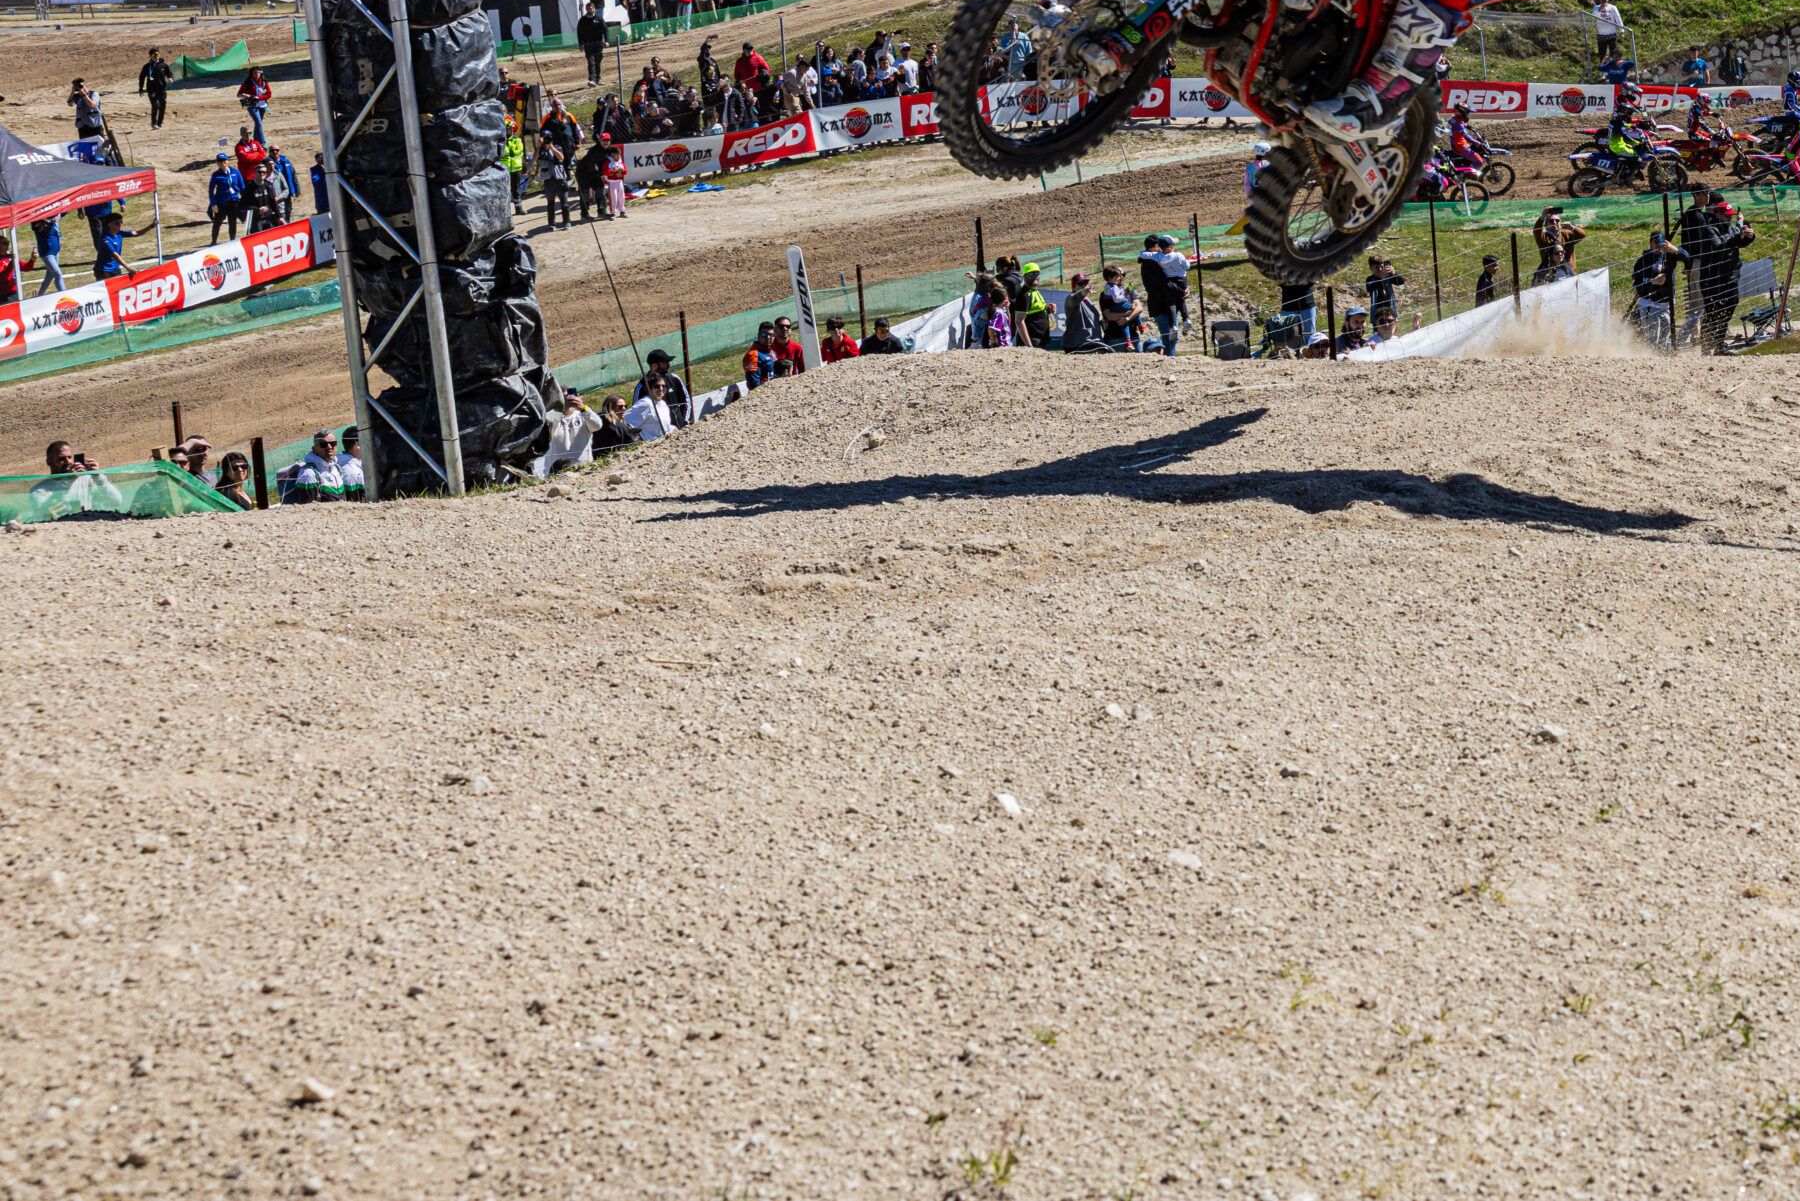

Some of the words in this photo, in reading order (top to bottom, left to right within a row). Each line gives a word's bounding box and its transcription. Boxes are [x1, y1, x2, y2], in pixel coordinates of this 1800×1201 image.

[1447, 90, 1522, 112] REDD
[1535, 93, 1607, 107] KATAYAMA
[820, 112, 894, 134] KATAYAMA
[727, 123, 807, 158] REDD
[9, 152, 54, 166] Bihr
[634, 148, 714, 169] KATAYAMA
[116, 180, 143, 193] Bihr
[253, 231, 310, 273] REDD
[188, 257, 243, 286] KATAYAMA
[118, 274, 180, 316] REDD
[797, 278, 815, 328] UFO
[32, 299, 106, 330] KATAYAMA
